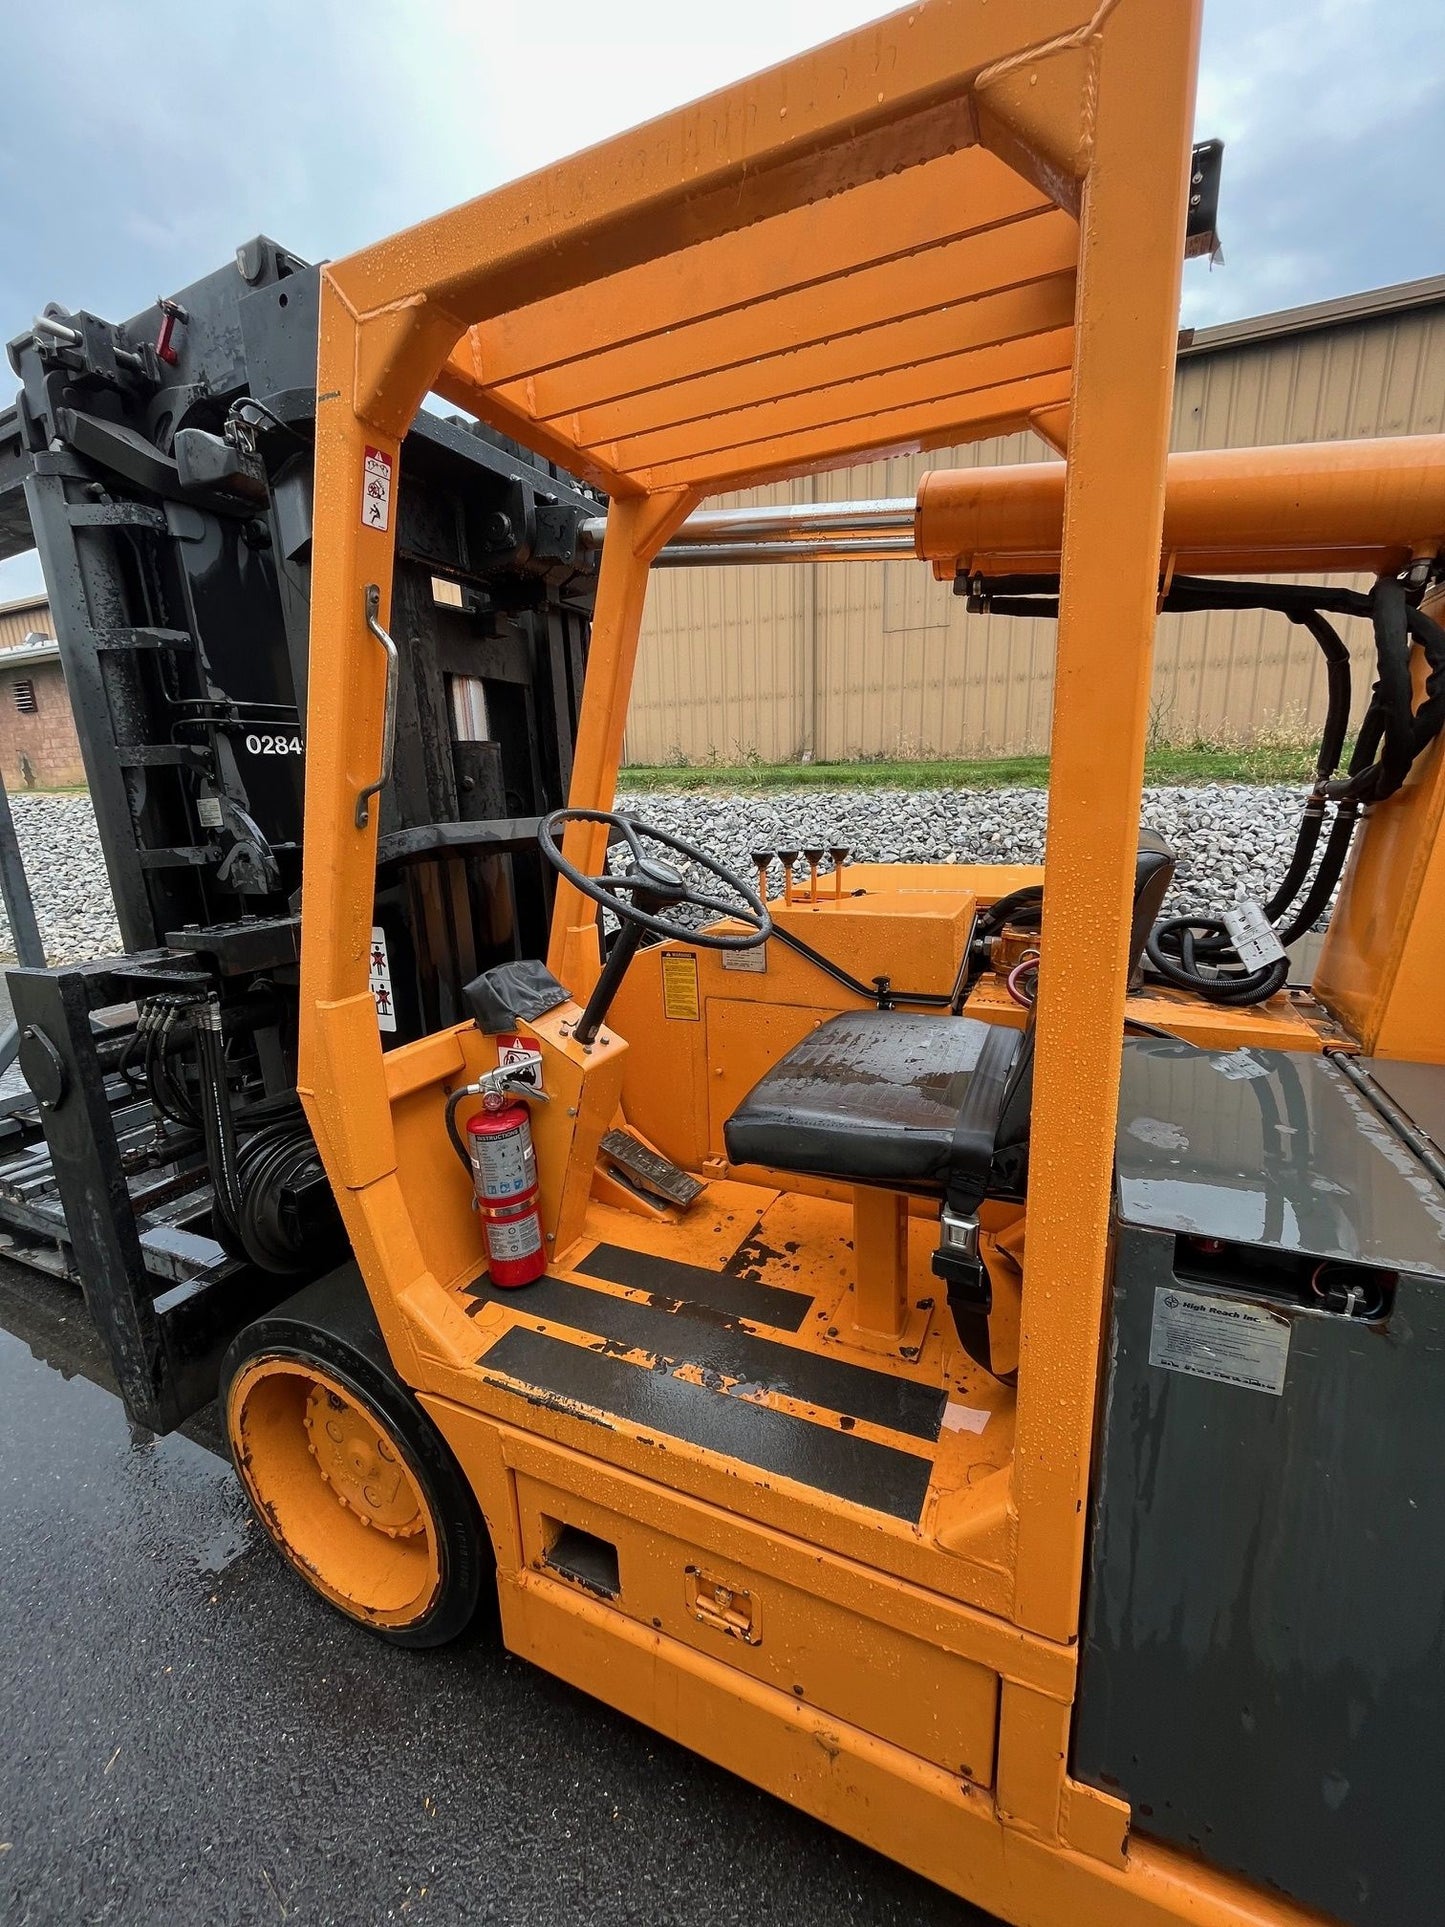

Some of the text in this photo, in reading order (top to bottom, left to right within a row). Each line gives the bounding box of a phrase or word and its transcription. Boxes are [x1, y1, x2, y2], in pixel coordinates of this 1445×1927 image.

[246, 735, 305, 754] 0284
[477, 1130, 519, 1141] INSTRUCTIONS
[1182, 1302, 1262, 1323] High Reach Inc.
